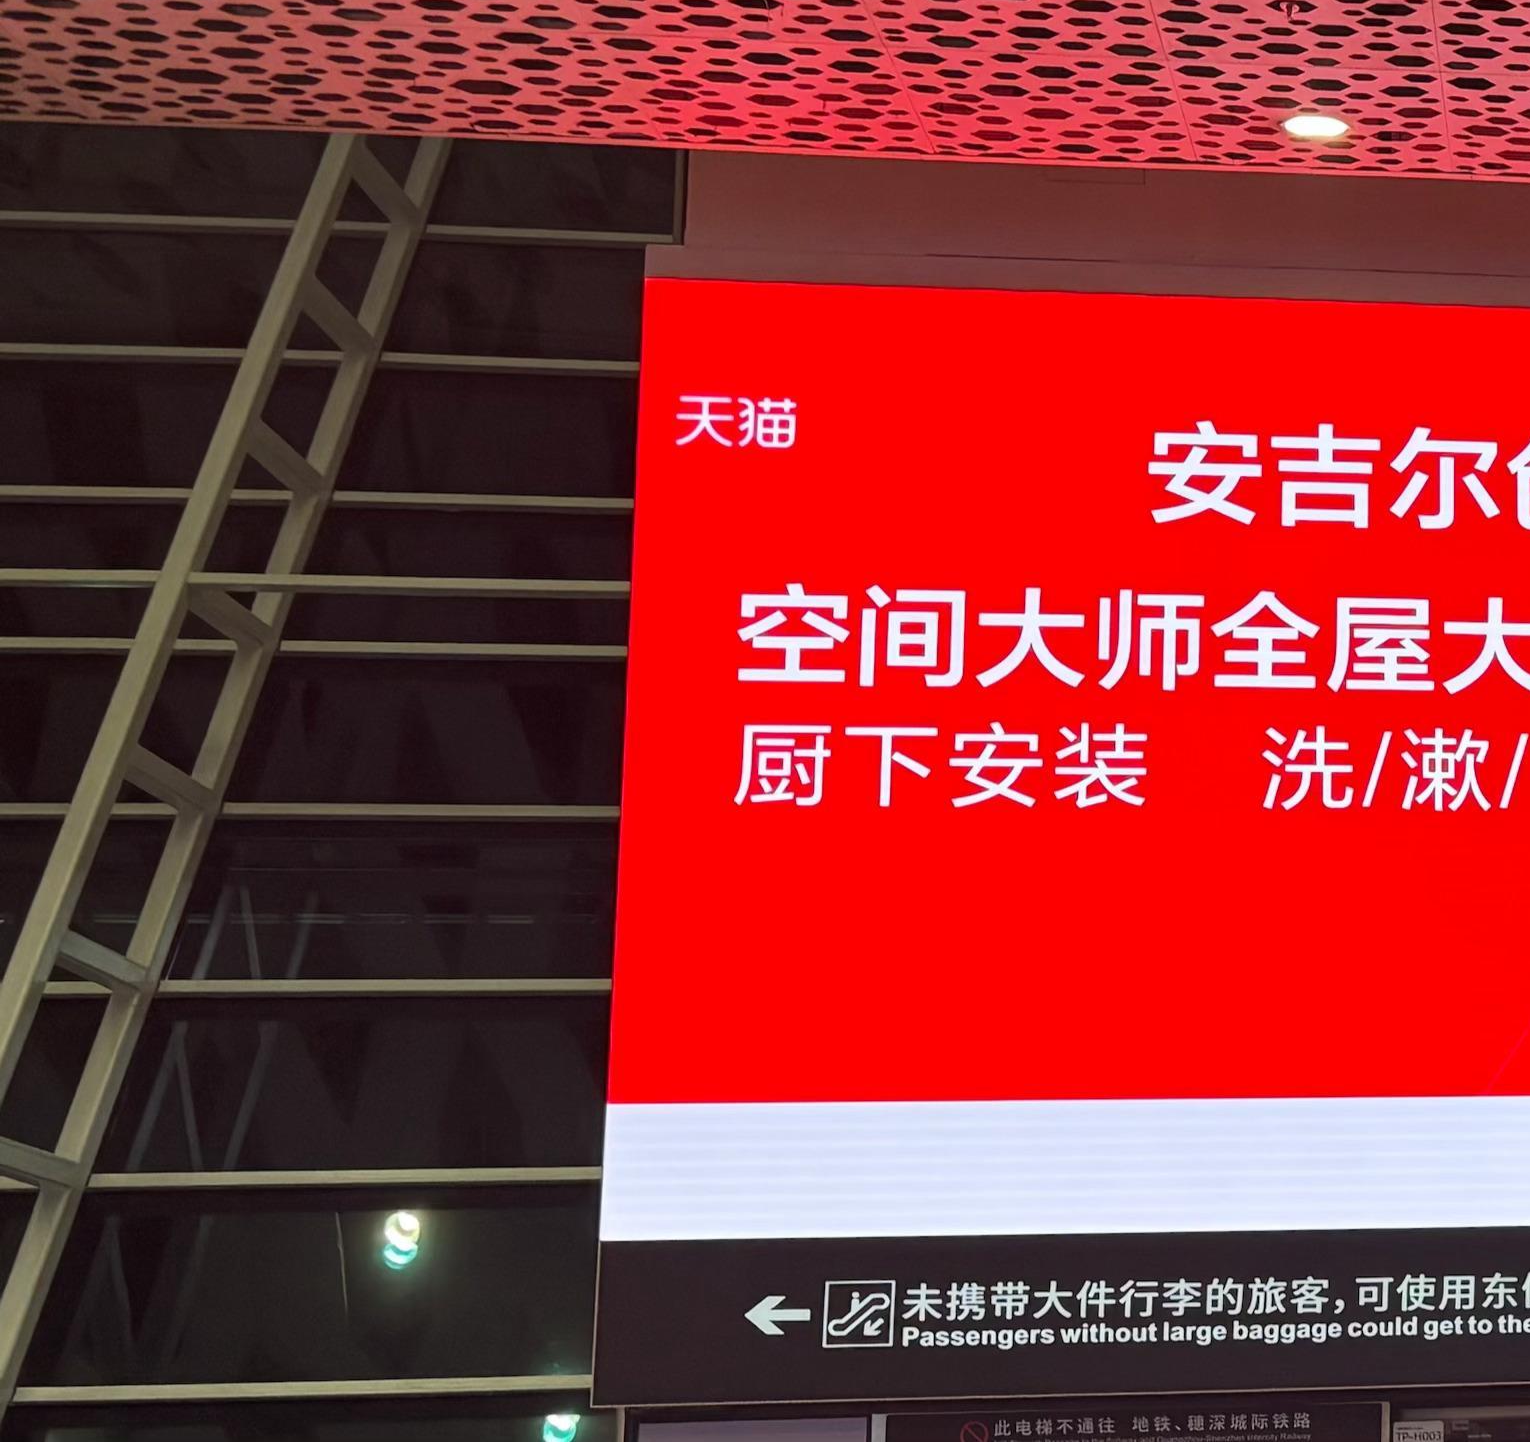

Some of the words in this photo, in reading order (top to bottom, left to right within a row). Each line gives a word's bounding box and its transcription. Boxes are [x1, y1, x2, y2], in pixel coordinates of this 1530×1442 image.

[673, 394, 799, 452] 天猫
[731, 720, 1151, 811] 厨下安装
[901, 1325, 1055, 1351] Passengers
[1060, 1321, 1157, 1344] without
[1163, 1319, 1228, 1347] large
[1231, 1318, 1343, 1345] baggage
[1347, 1316, 1419, 1338] could
[1423, 1318, 1463, 1340] get
[1465, 1316, 1492, 1335] to
[993, 1415, 1116, 1438] 此电梯不通往
[1131, 1411, 1311, 1435] 地铁、穗深城际铁路
